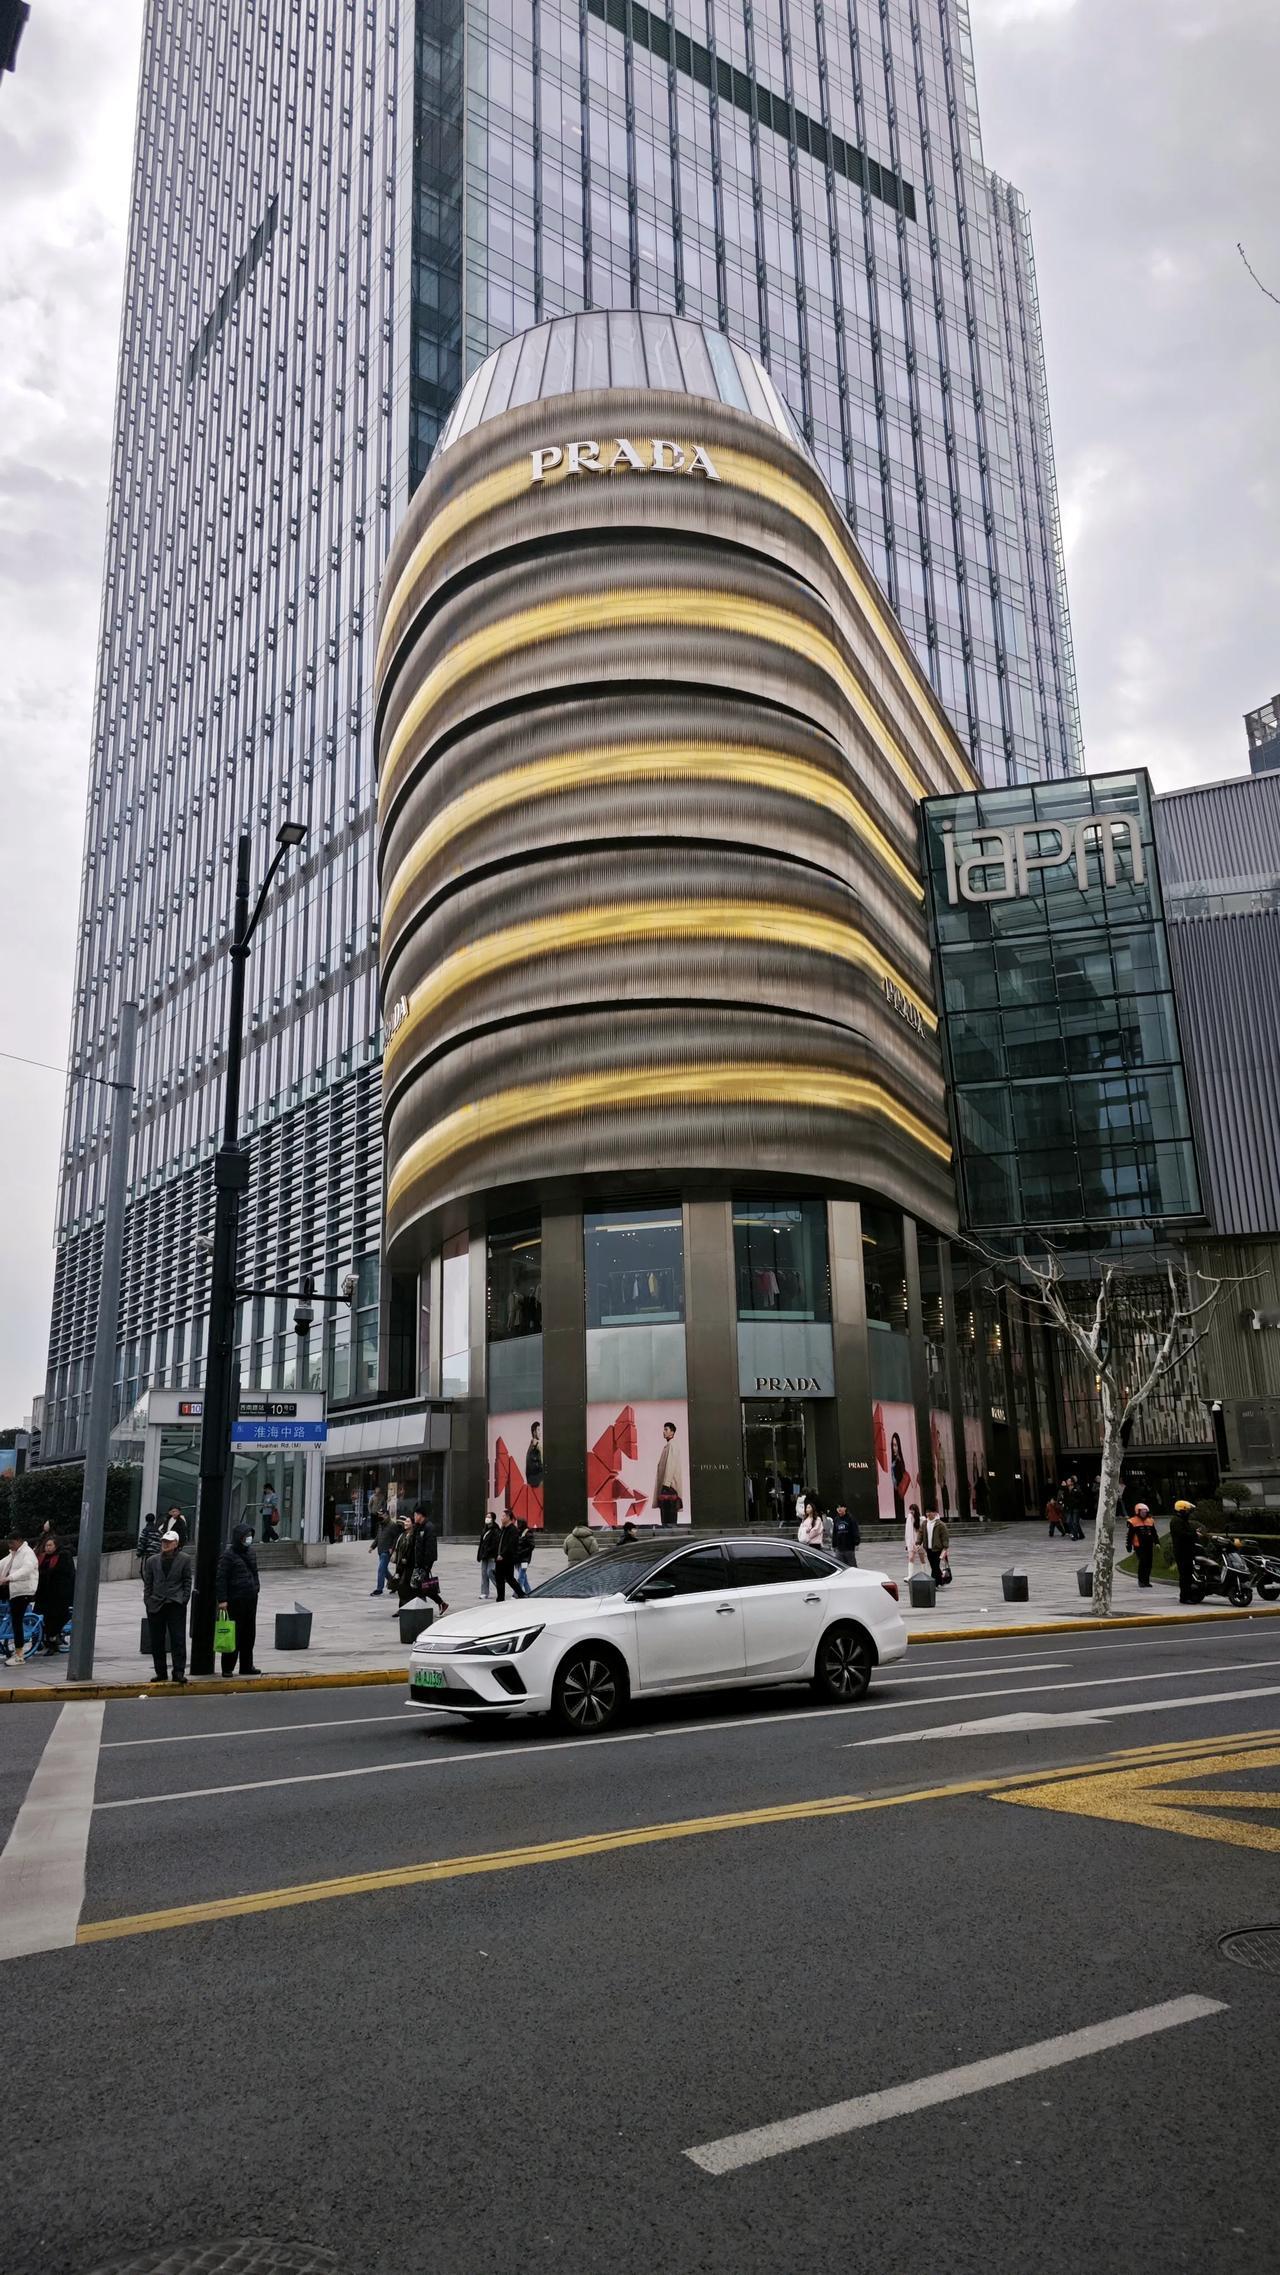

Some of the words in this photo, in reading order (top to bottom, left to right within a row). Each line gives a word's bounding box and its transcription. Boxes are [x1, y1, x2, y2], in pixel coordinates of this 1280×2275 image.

[529, 438, 721, 482] PRADA
[755, 1377, 821, 1391] PRADA
[254, 1426, 305, 1438] 淮海中路
